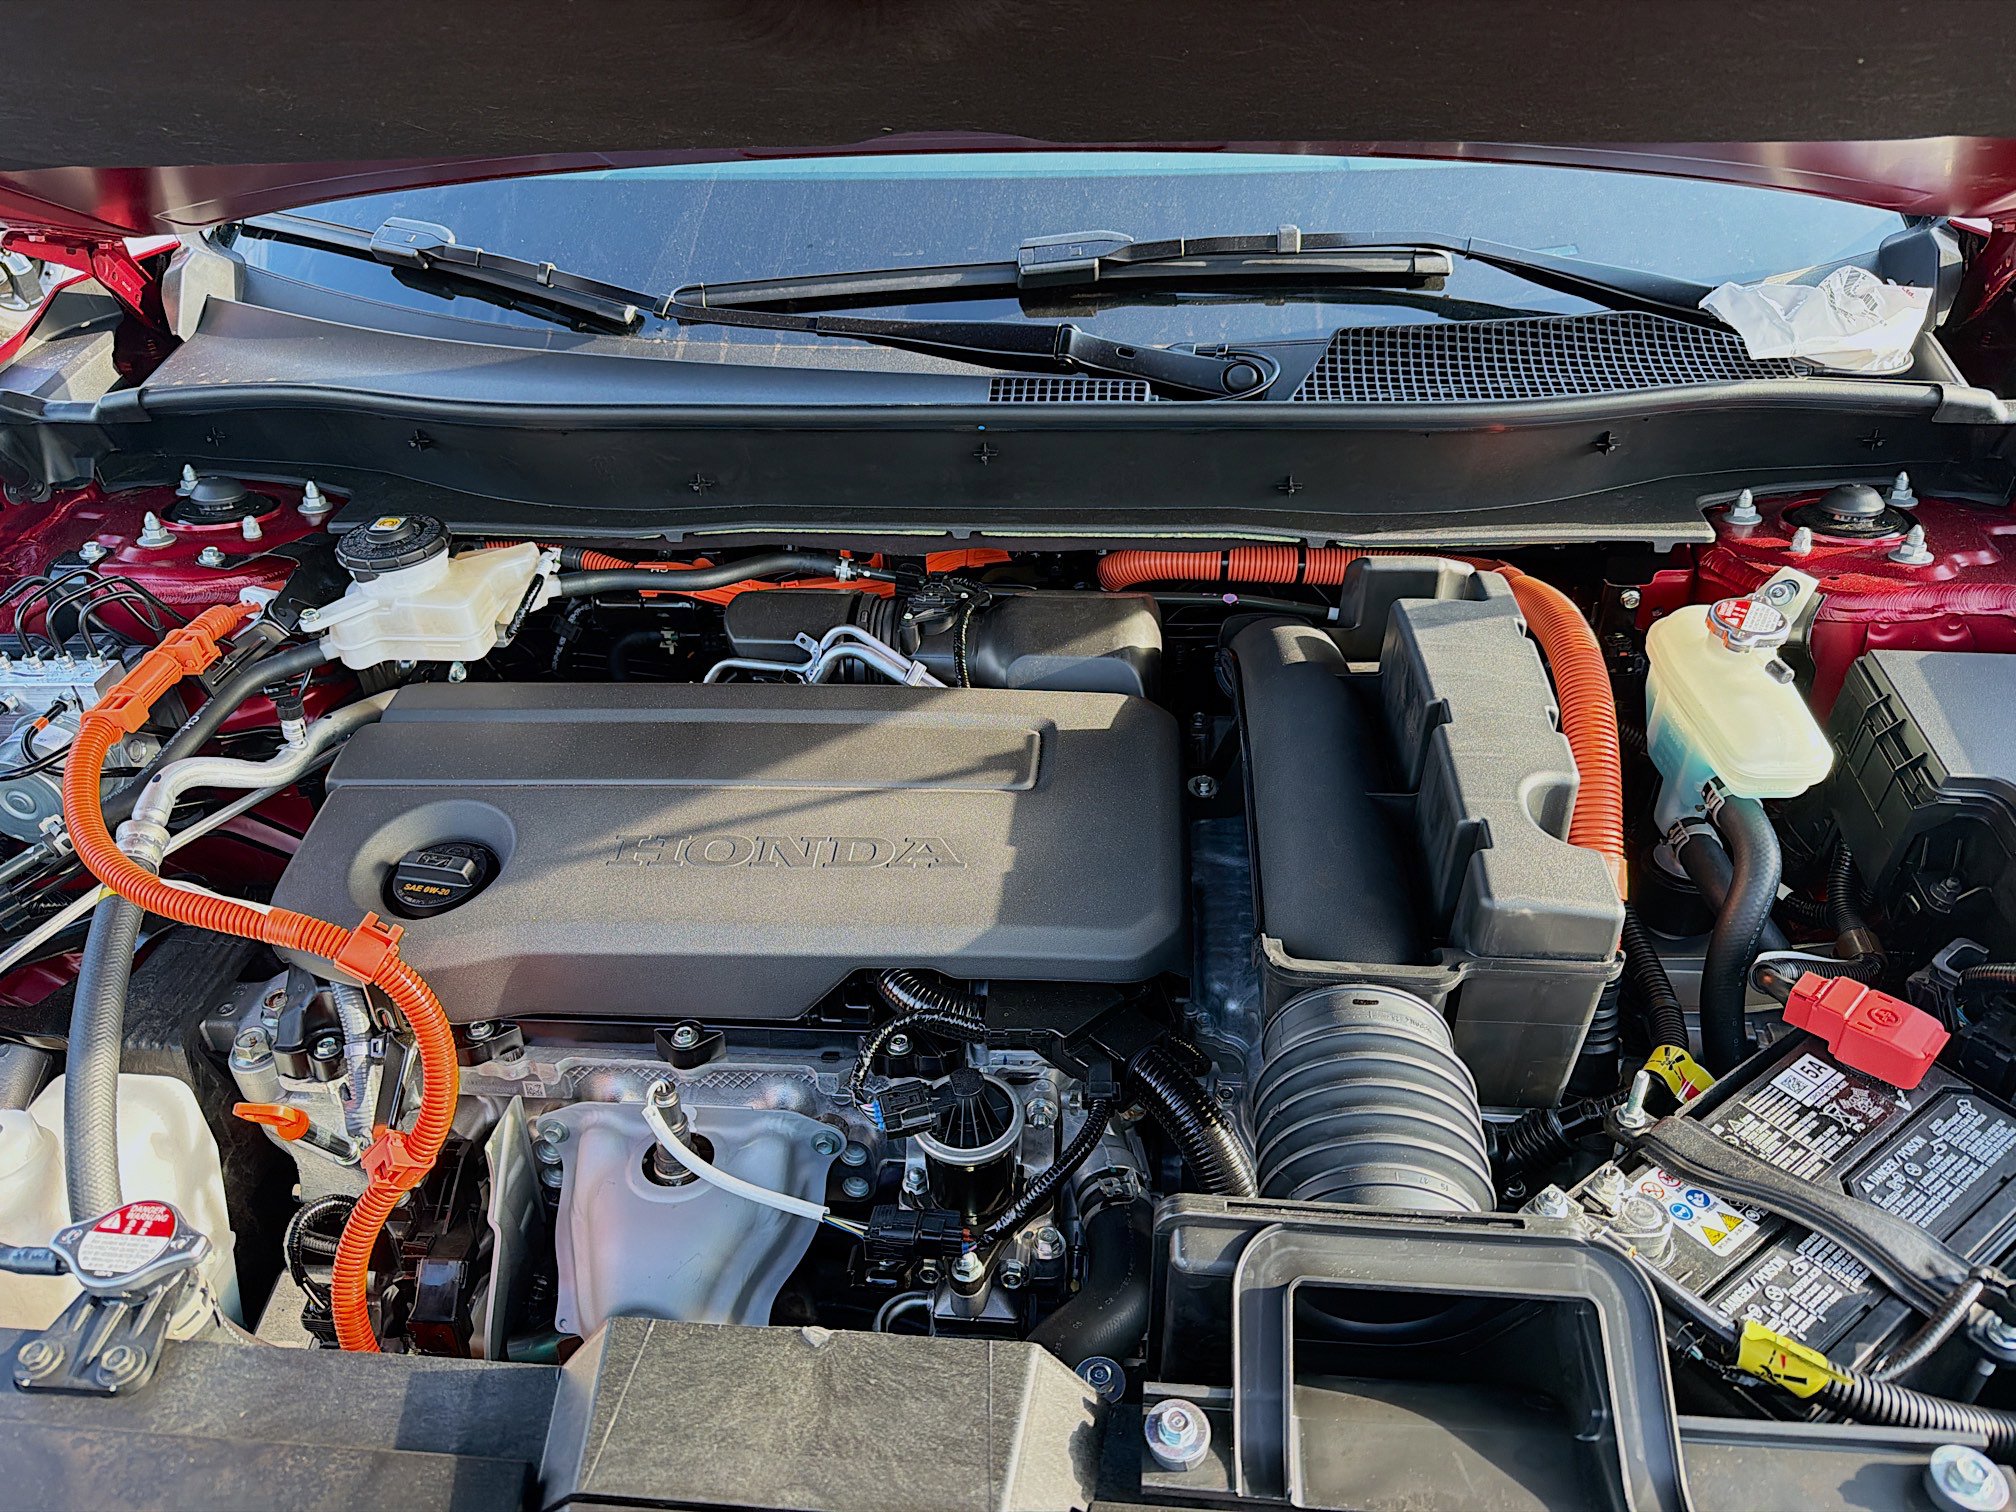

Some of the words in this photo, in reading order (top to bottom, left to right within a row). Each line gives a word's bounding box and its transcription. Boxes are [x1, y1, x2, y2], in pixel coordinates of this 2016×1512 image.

[605, 835, 968, 868] HONDA
[403, 883, 424, 892] SAE
[423, 886, 451, 896] 0W-20
[1800, 1060, 1828, 1079] 5A
[131, 1204, 167, 1214] DANGER
